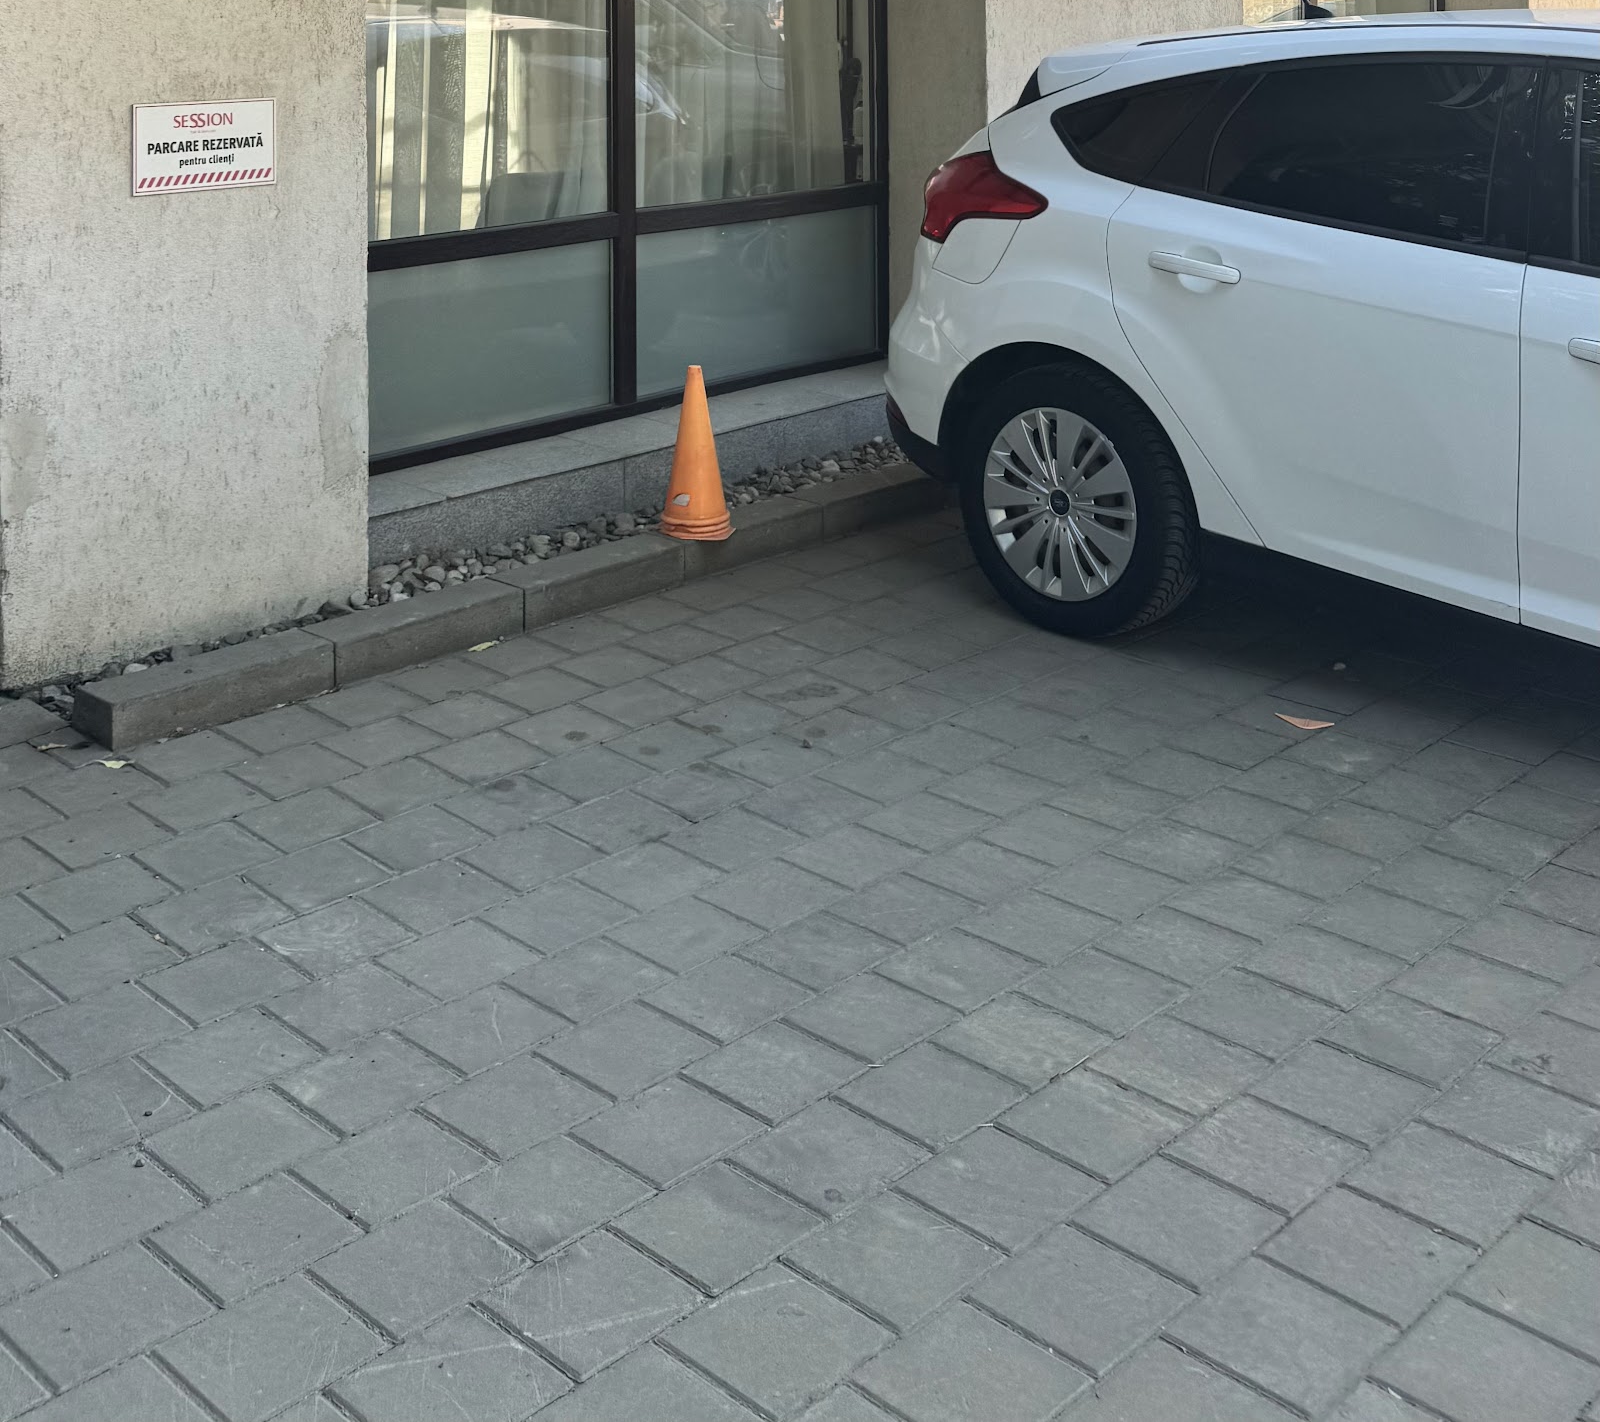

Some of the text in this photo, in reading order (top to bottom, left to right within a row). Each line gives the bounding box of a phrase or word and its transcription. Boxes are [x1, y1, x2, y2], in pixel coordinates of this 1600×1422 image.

[173, 112, 233, 129] SESSION
[147, 132, 264, 155] PARCARE REZERVATĂ
[179, 156, 207, 169] pentru
